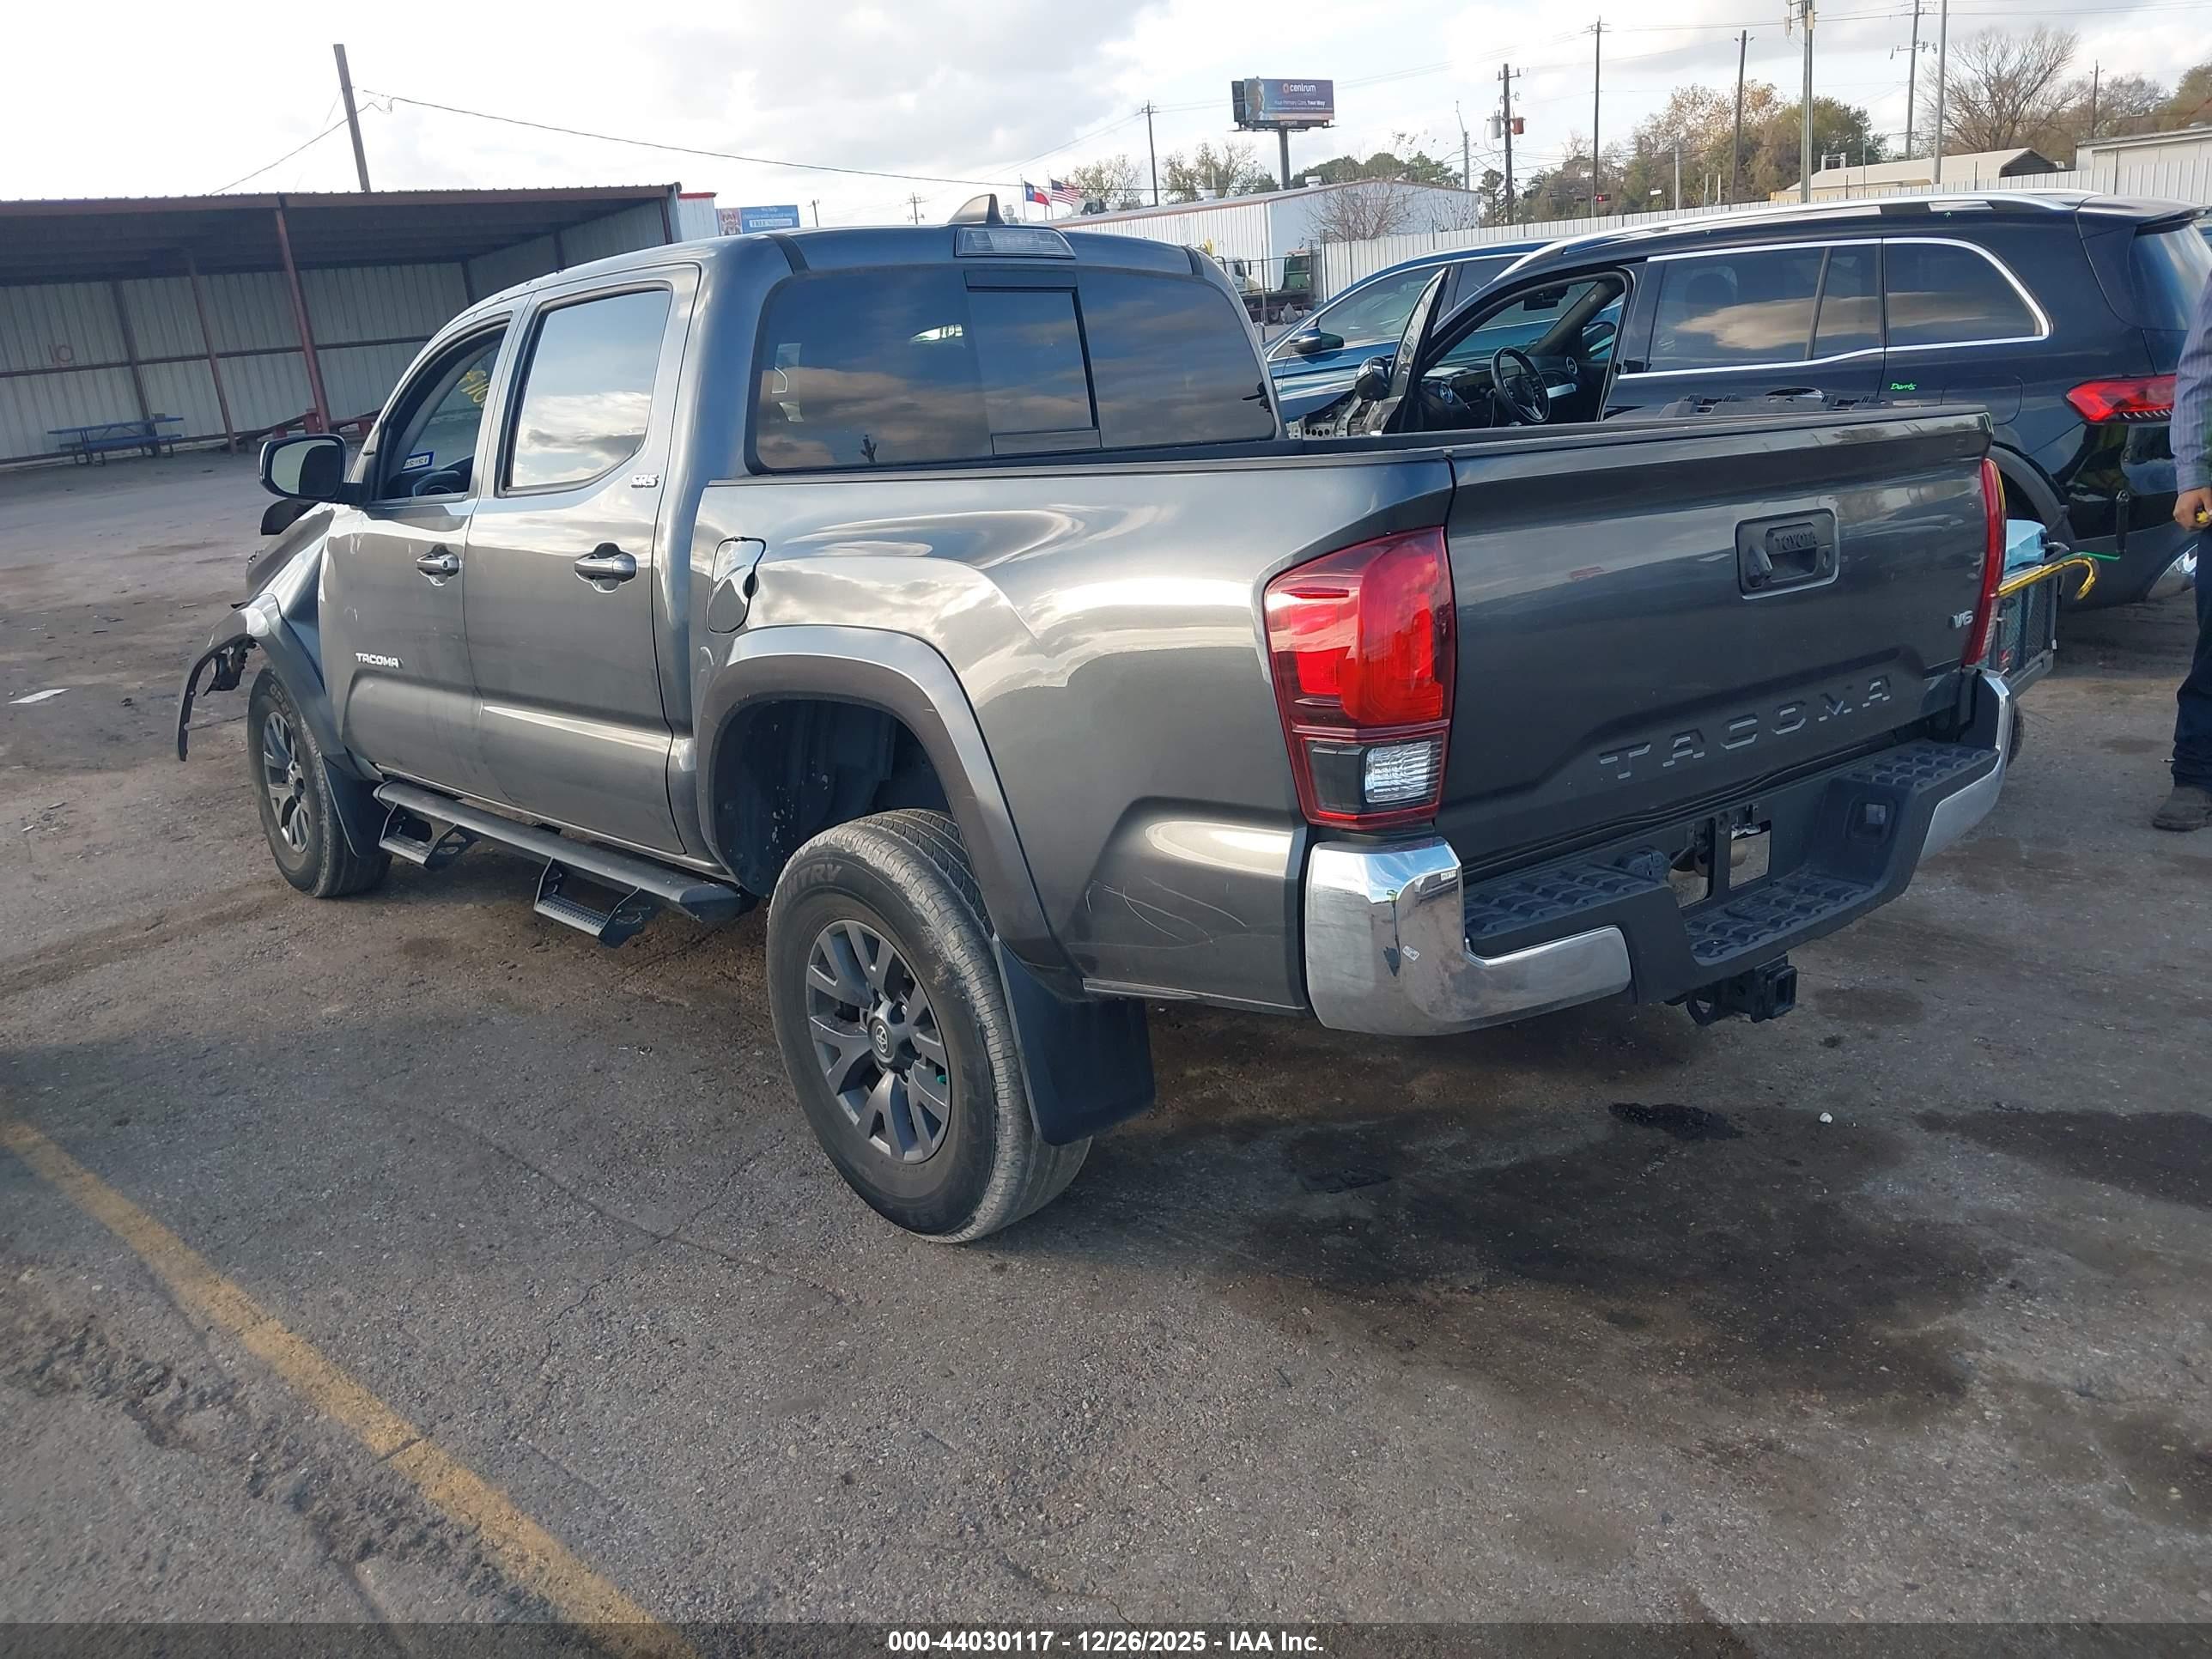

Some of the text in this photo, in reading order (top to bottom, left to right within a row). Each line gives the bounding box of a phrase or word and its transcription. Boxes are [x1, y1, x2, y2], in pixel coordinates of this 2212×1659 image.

[1290, 82, 1316, 93] centrum
[631, 473, 659, 488] SR5
[1771, 531, 1820, 550] TOYOTA
[1950, 610, 1973, 629] V6
[355, 652, 400, 669] TACOMA
[1599, 674, 1893, 780] TACOMA
